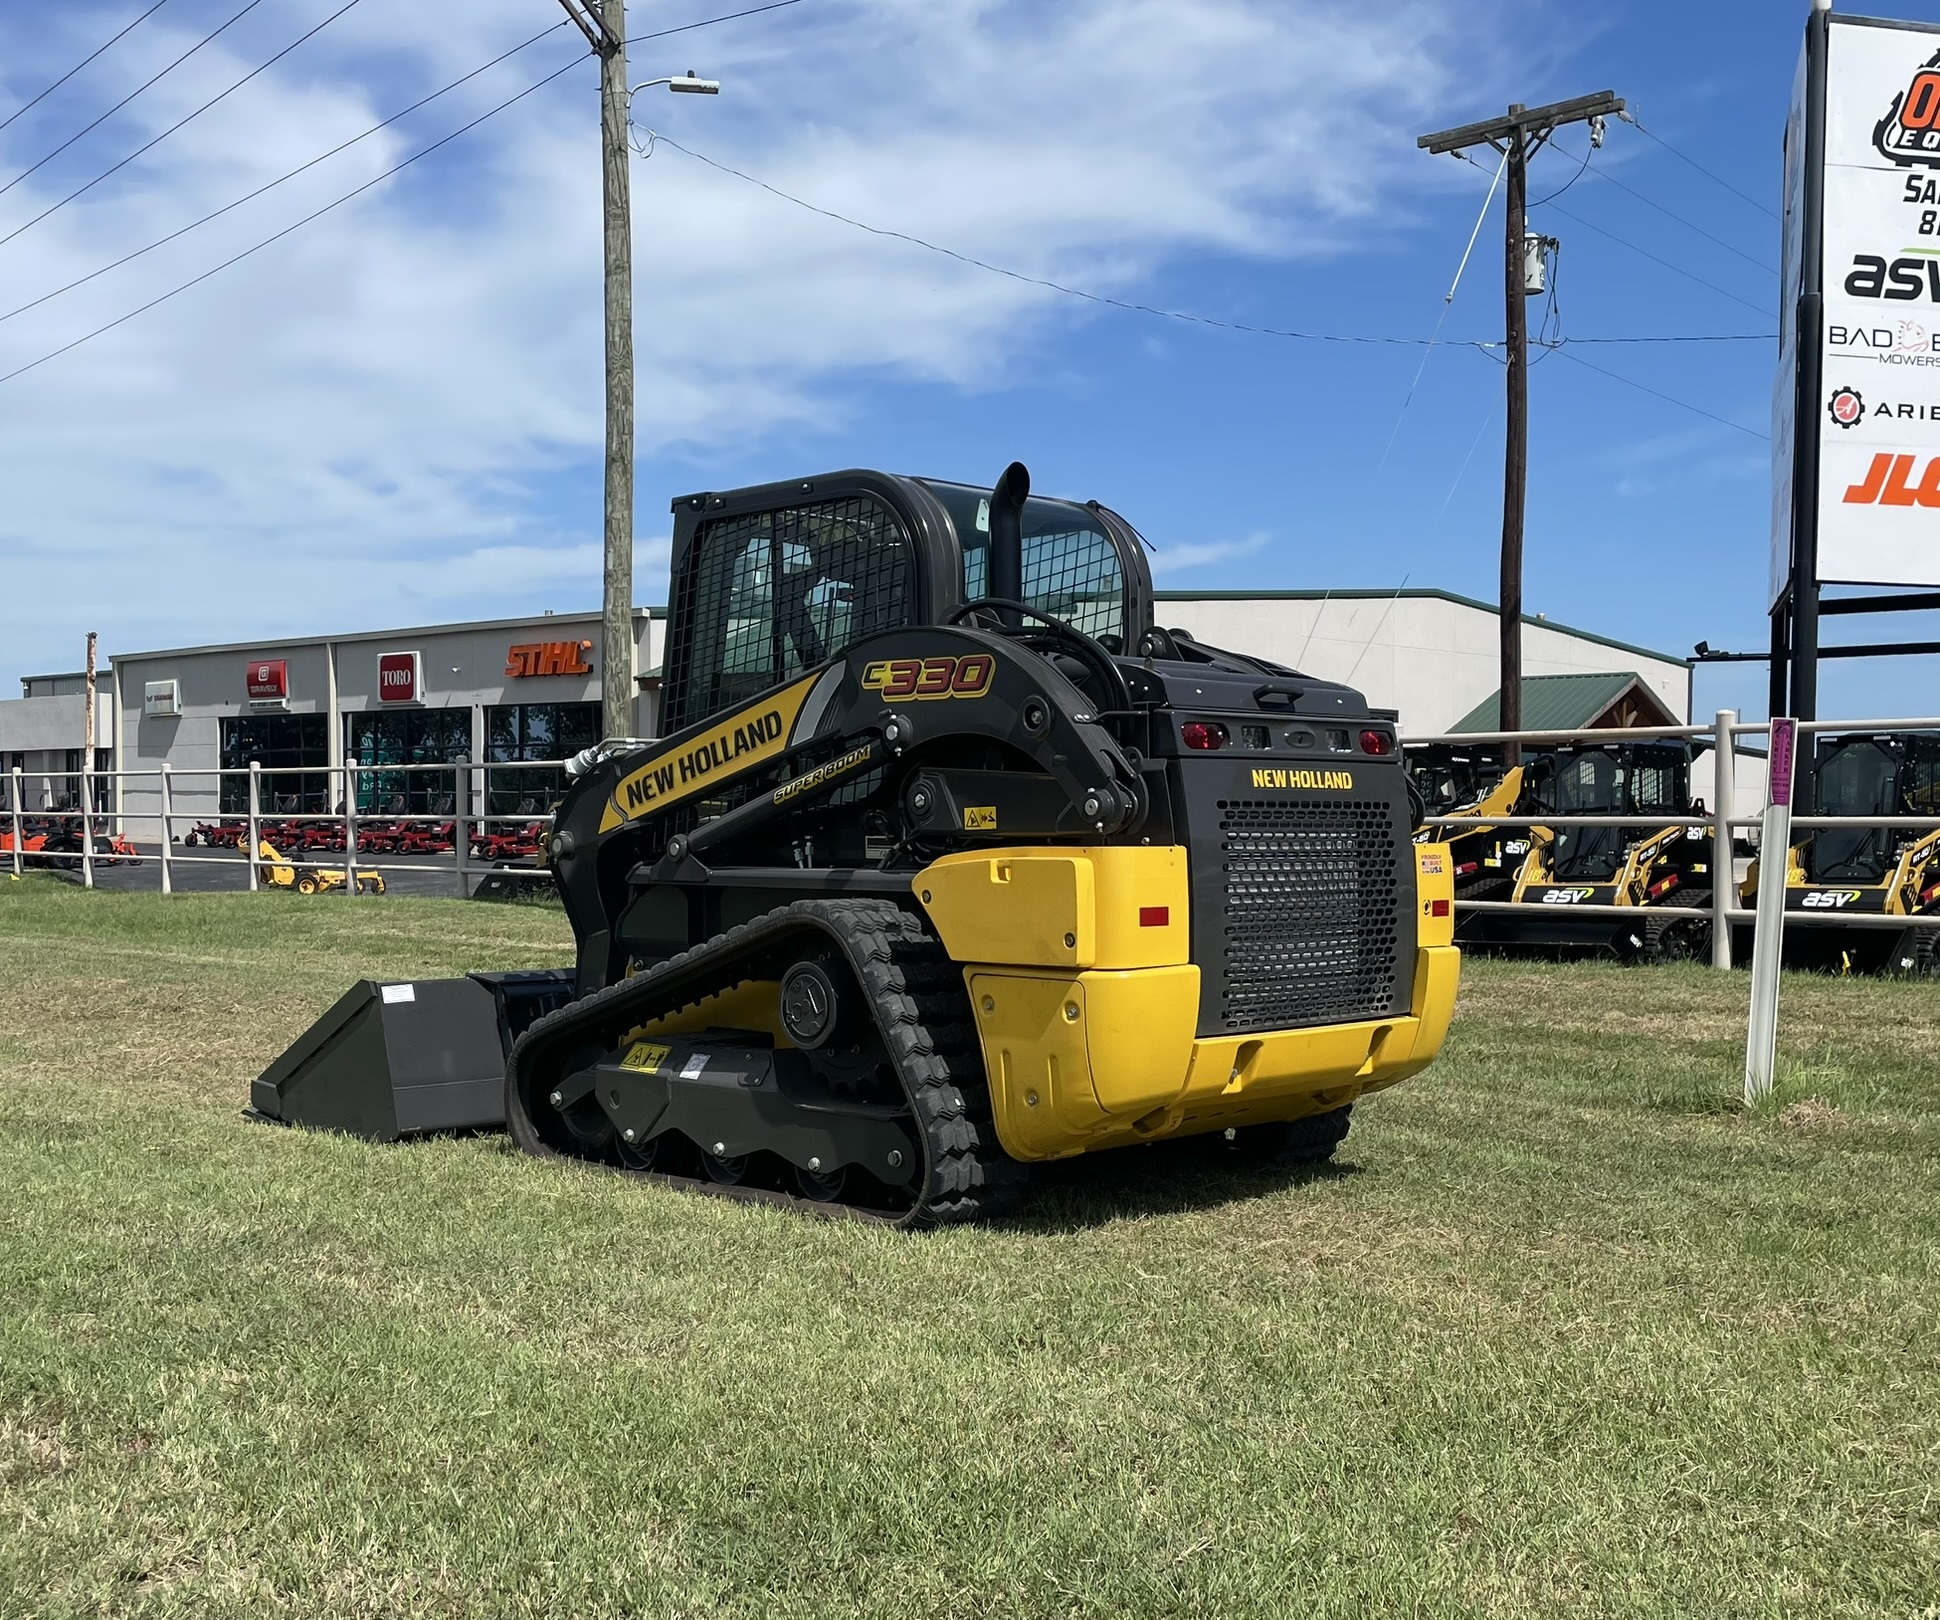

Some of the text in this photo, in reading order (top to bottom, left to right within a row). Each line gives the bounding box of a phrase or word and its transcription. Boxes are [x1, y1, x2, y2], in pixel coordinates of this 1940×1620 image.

[1901, 73, 1940, 129] O
[1902, 174, 1940, 204] SA
[1918, 209, 1940, 236] 8
[1829, 325, 1893, 348] BAD
[504, 641, 588, 677] STIHL
[381, 669, 411, 687] TORO
[863, 655, 995, 701] C330
[626, 710, 783, 810] NEW HOLLAND
[773, 744, 871, 805] SUPER BOOM
[1251, 769, 1353, 790] NEW HOLLAND
[1505, 840, 1529, 854] asv
[1543, 888, 1589, 904] asv
[1802, 891, 1856, 907] asv
